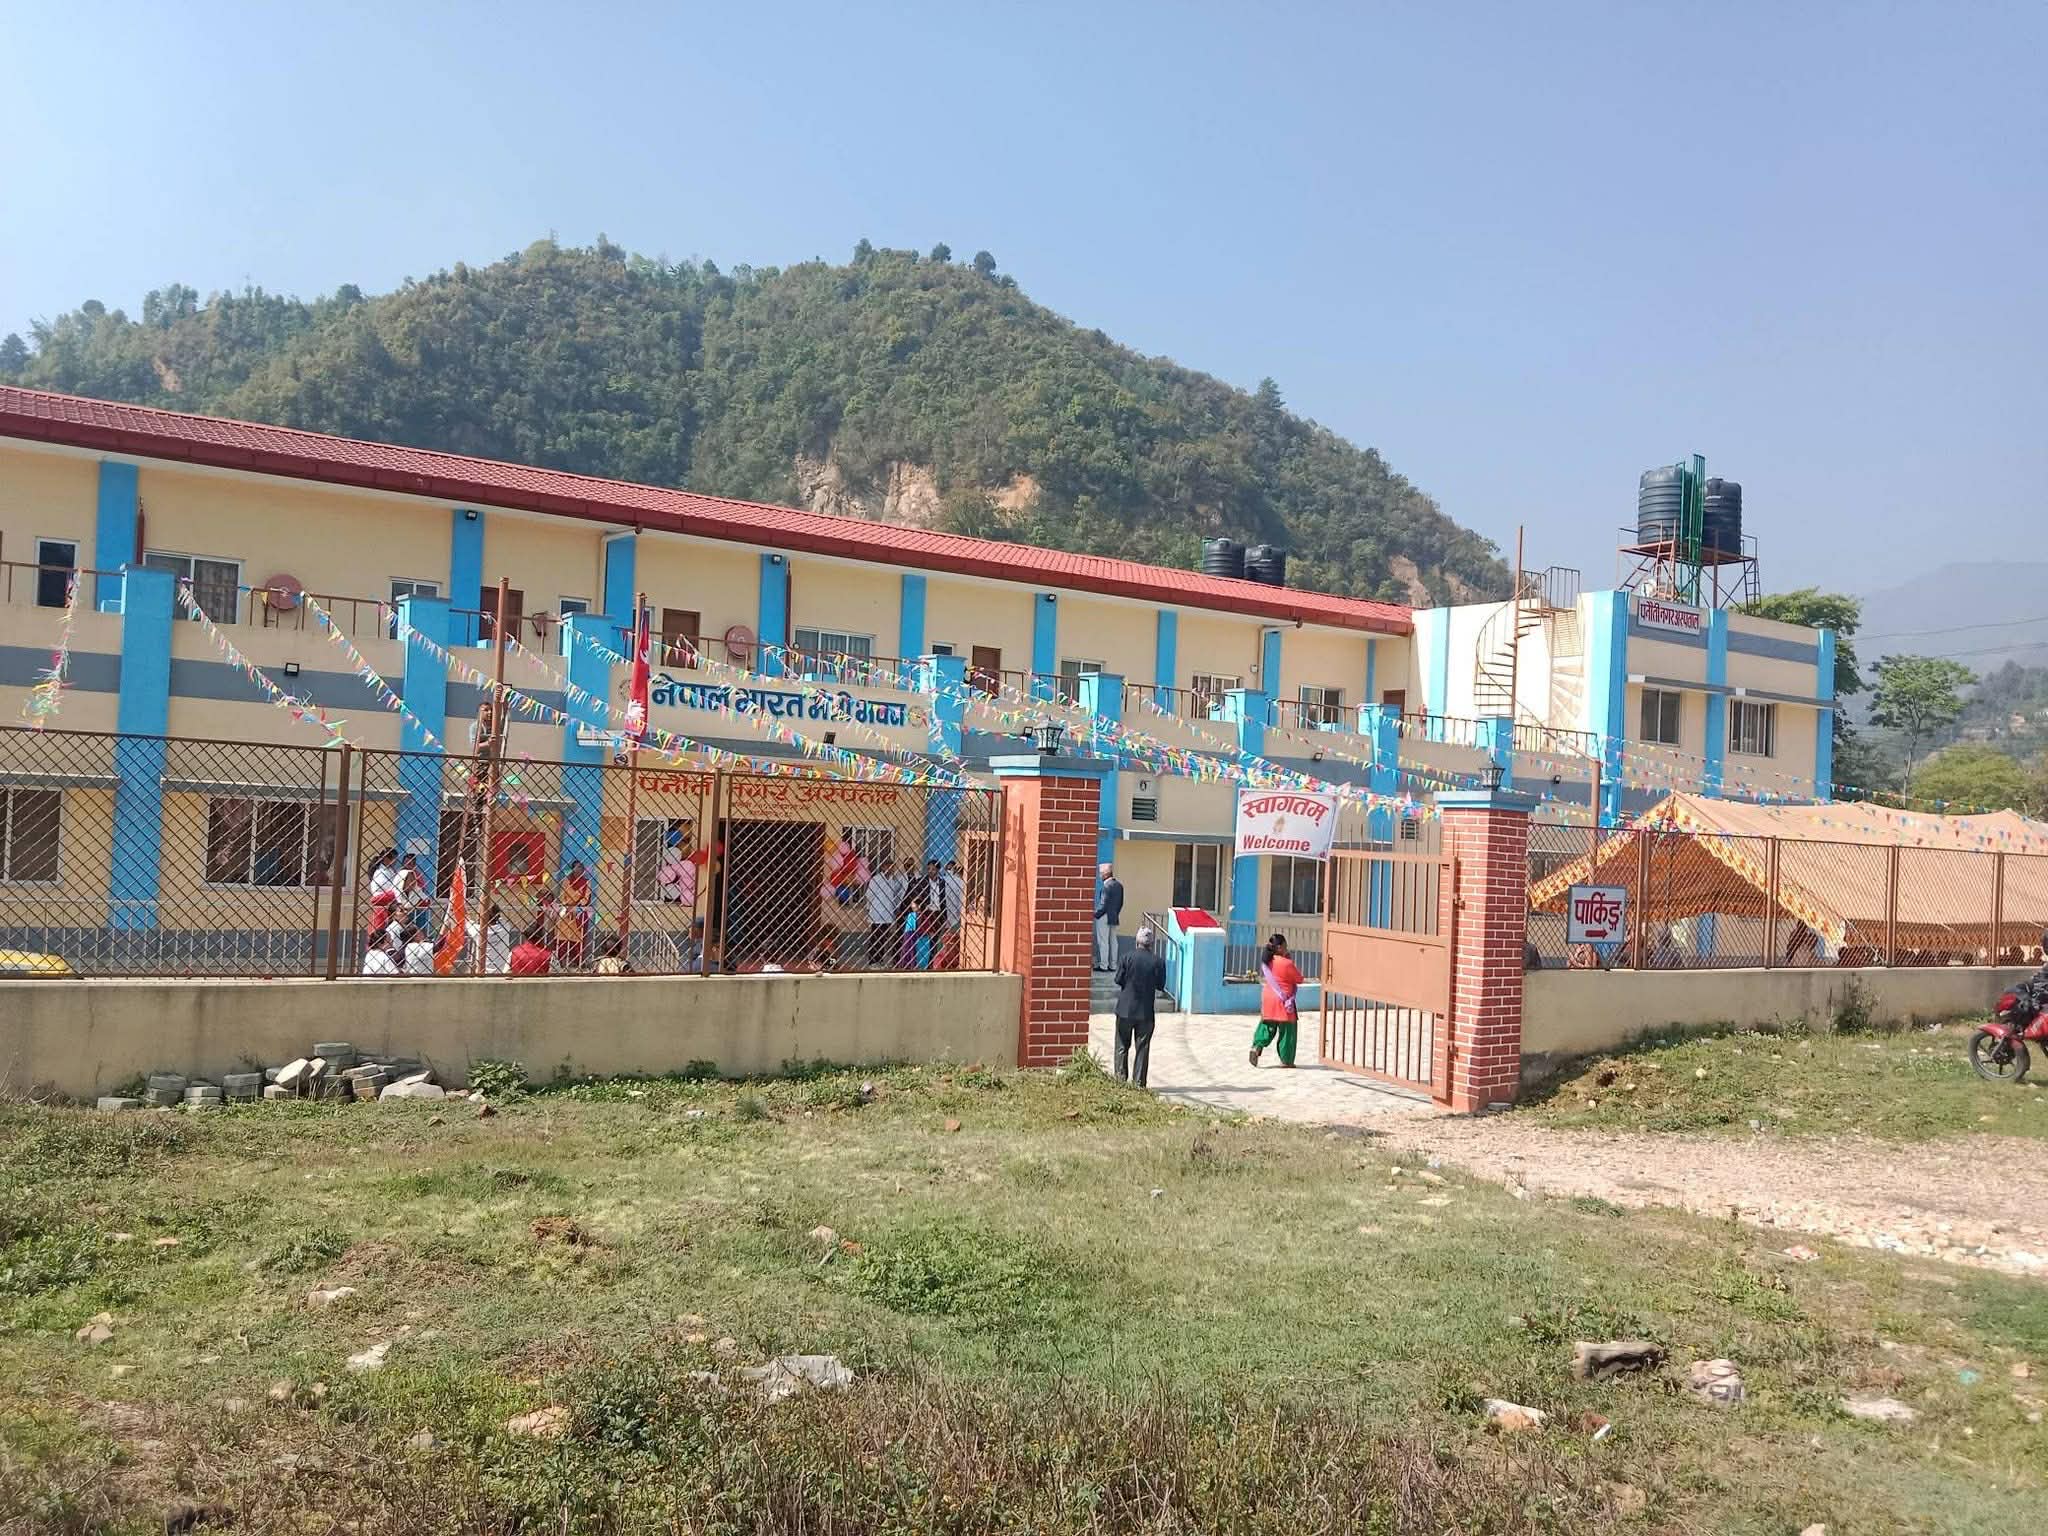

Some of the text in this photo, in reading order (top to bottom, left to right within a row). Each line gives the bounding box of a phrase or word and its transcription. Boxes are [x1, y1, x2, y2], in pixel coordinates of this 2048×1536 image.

[651, 673, 731, 711] नेपाल
[1242, 796, 1329, 827] स्वागतम्
[1243, 834, 1311, 852] Welcome
